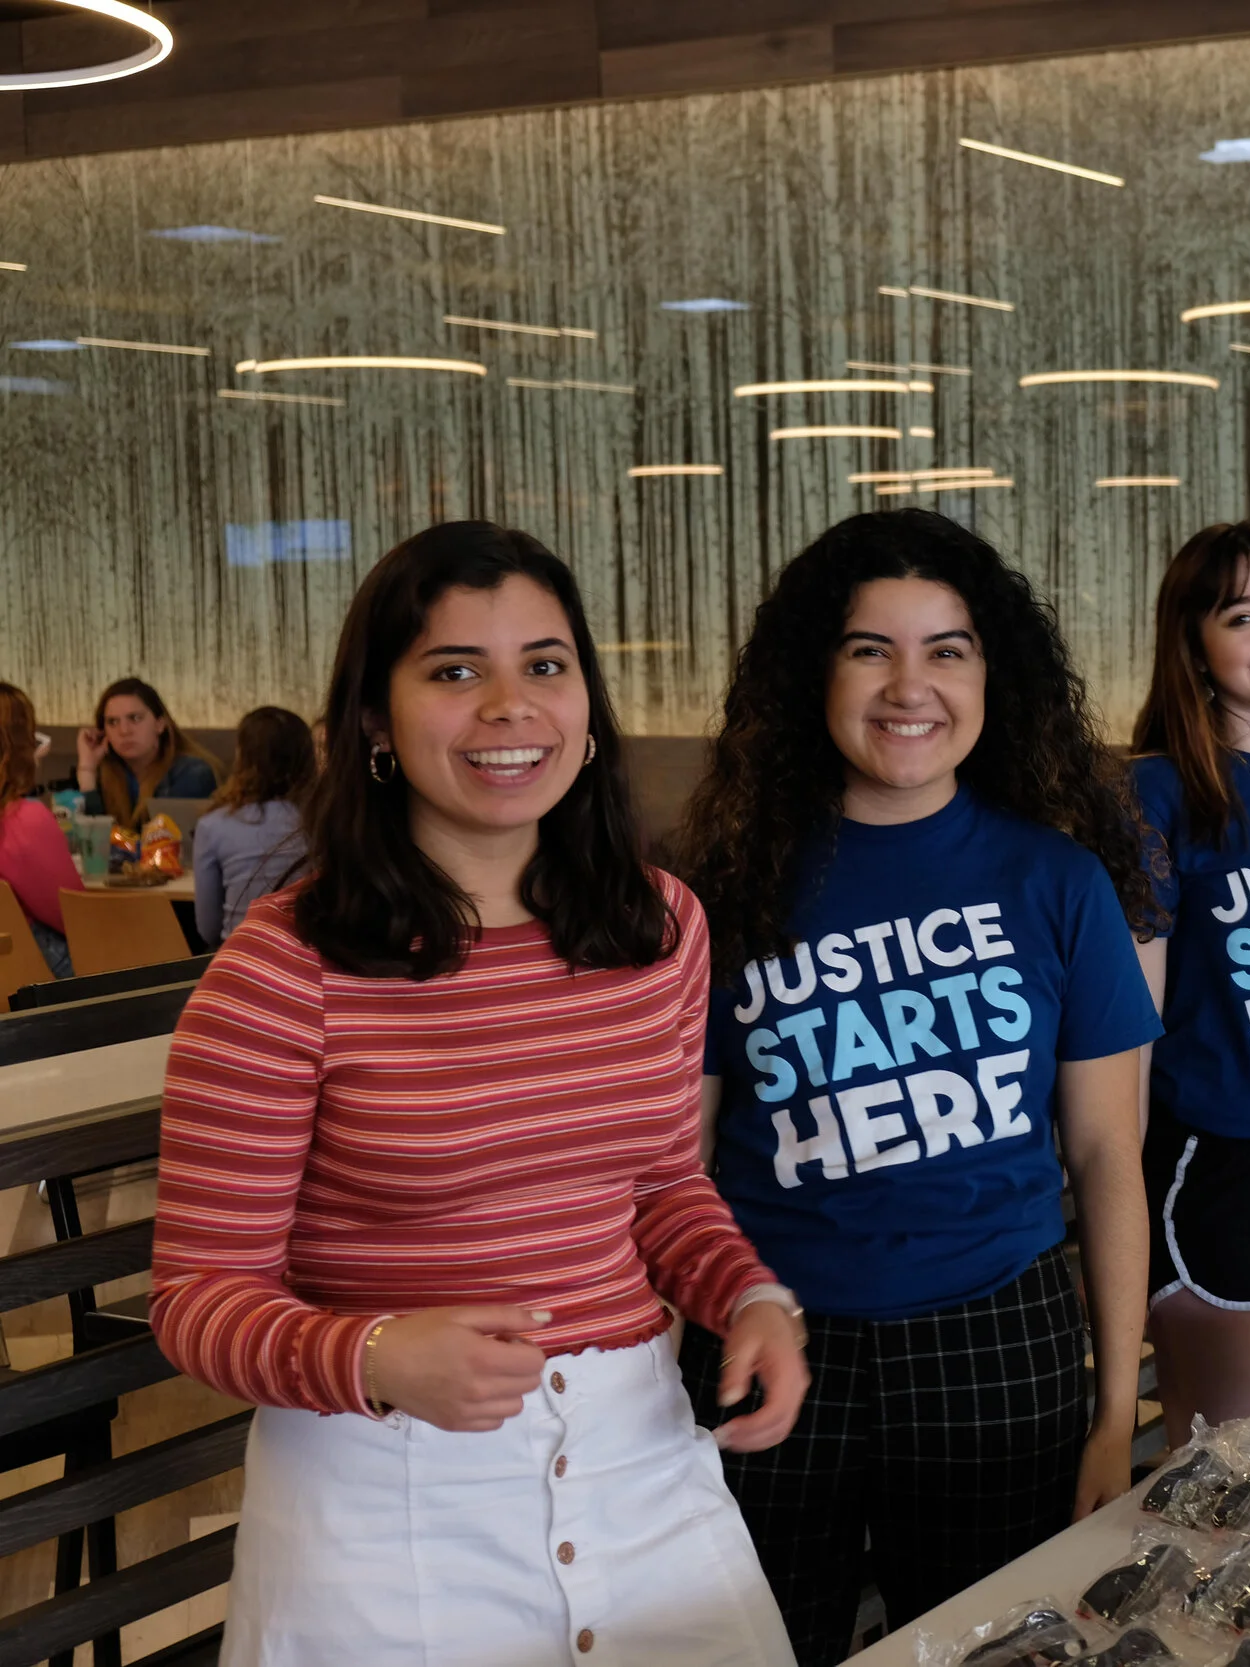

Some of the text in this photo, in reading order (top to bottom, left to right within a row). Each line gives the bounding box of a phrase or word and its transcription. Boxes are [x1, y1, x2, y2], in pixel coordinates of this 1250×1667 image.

[734, 902, 1015, 1024] JUSTICE
[746, 965, 1032, 1102] STARTS
[770, 1049, 1032, 1189] HERE
